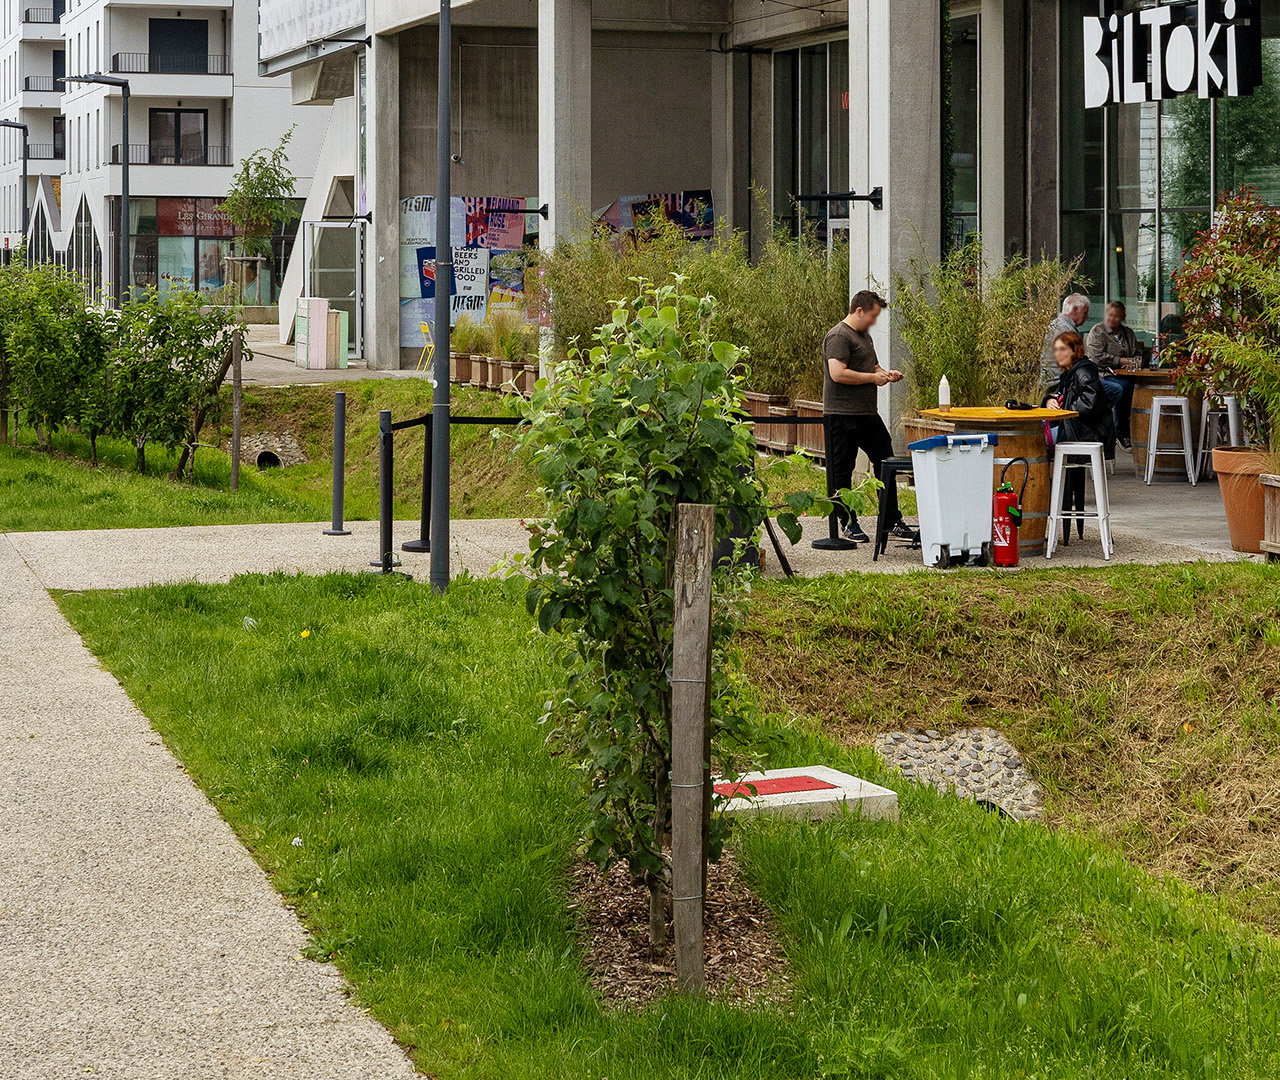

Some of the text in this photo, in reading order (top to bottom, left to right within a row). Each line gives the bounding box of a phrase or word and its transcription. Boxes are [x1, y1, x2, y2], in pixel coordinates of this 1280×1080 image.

[178, 211, 194, 220] LES
[454, 252, 479, 260] BEERS
[453, 259, 470, 267] AND
[453, 266, 486, 275] GRILLED
